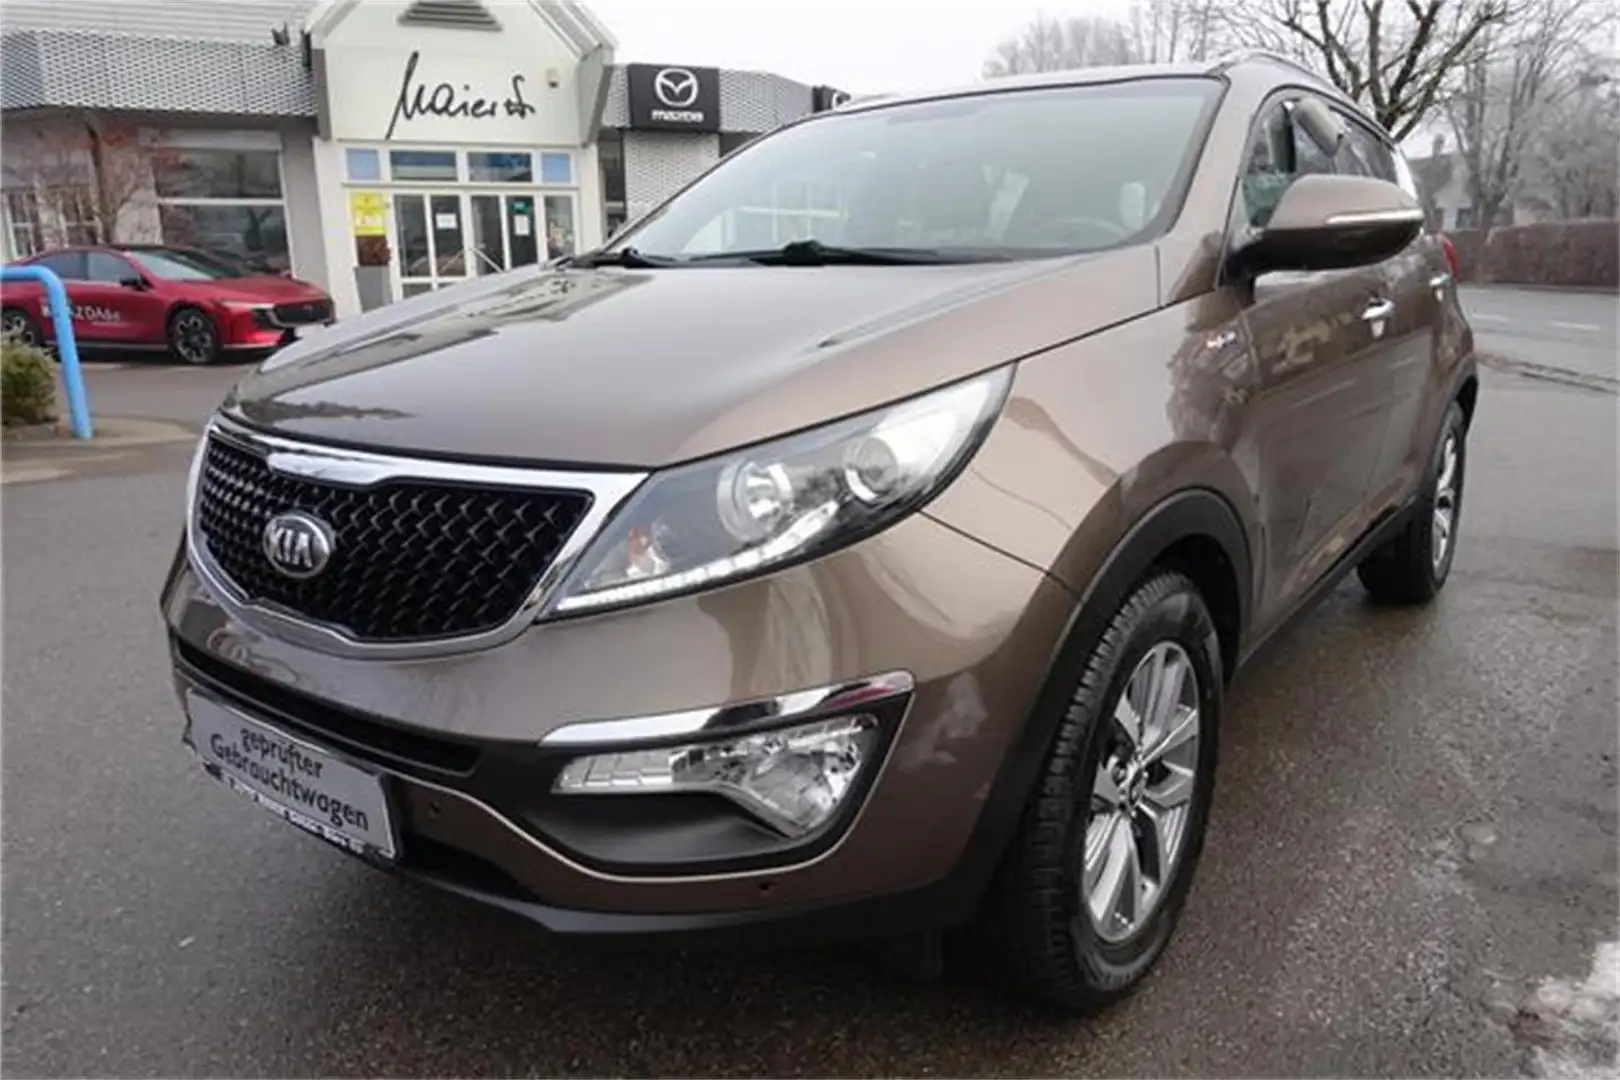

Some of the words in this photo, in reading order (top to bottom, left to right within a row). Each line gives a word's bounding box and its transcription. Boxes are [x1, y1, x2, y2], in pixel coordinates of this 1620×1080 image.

[385, 51, 498, 140] Maier
[267, 525, 313, 568] KIA
[210, 732, 369, 831] Gebrauchtwagen
[240, 726, 325, 779] geprüfter
